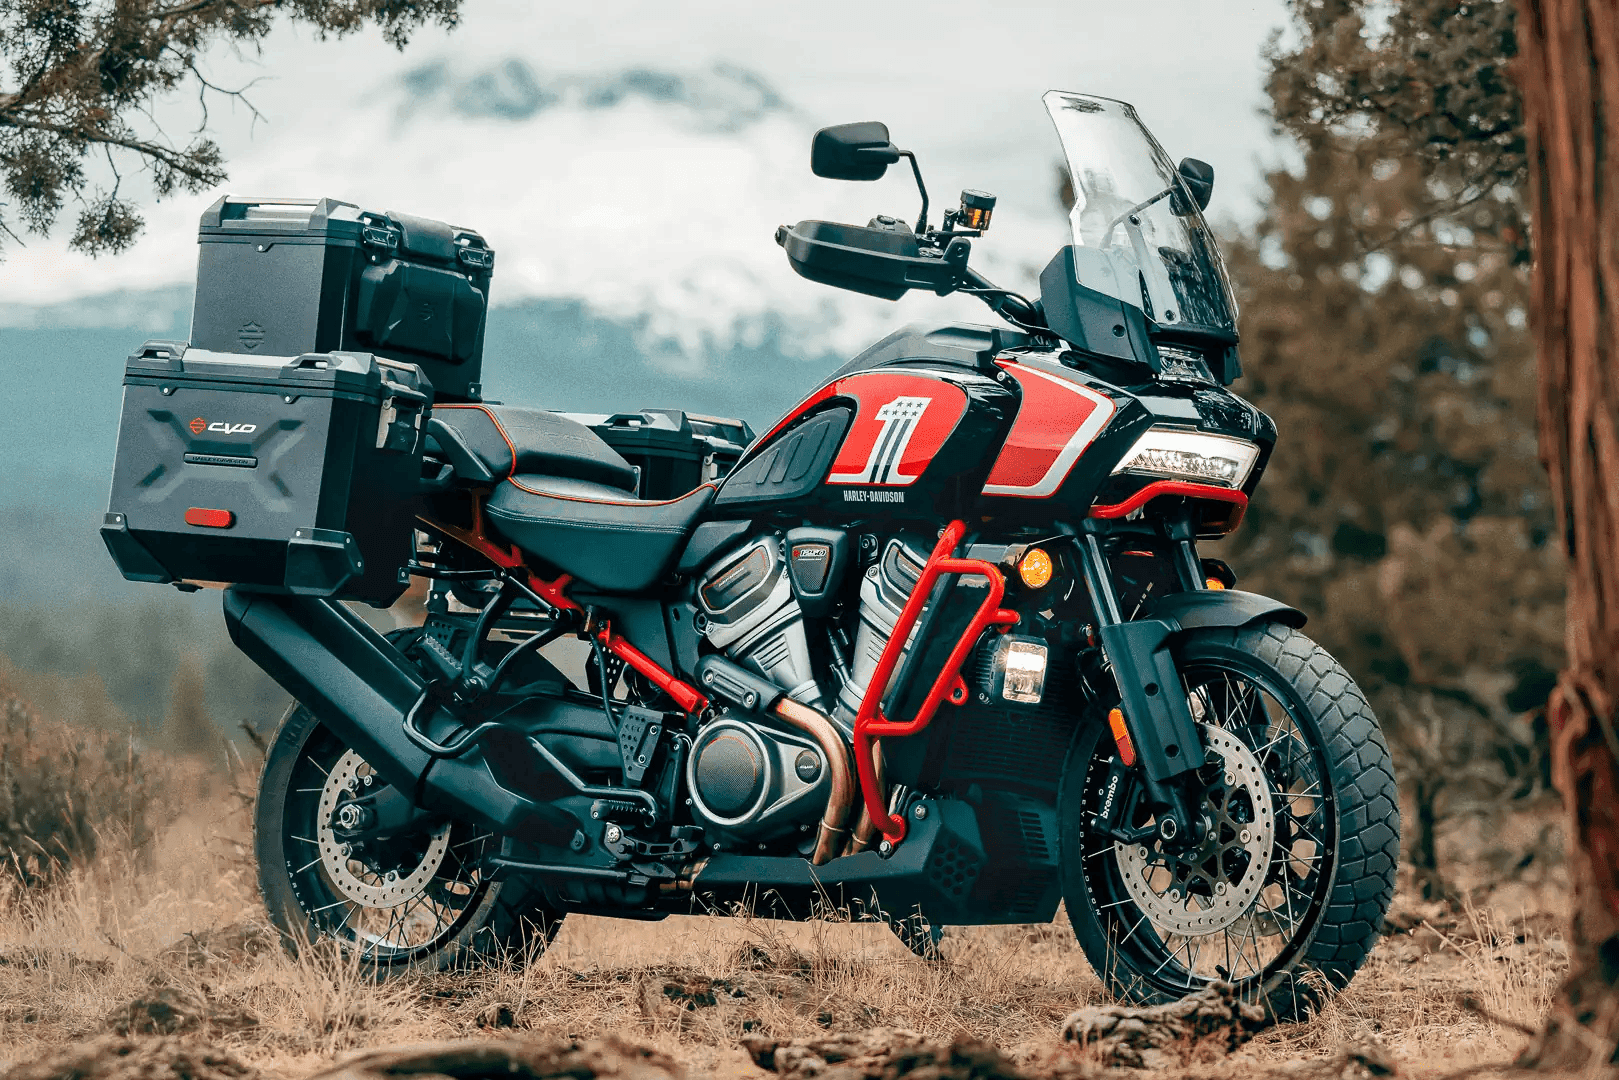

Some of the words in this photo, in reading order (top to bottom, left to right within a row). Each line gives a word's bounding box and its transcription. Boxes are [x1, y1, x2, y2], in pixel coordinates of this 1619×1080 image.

[208, 422, 257, 434] CVO
[843, 490, 904, 502] HARLEY-DAVIDSON
[1101, 775, 1119, 819] brembo
[1080, 753, 1101, 916] HARLEY-DAVIDSON
